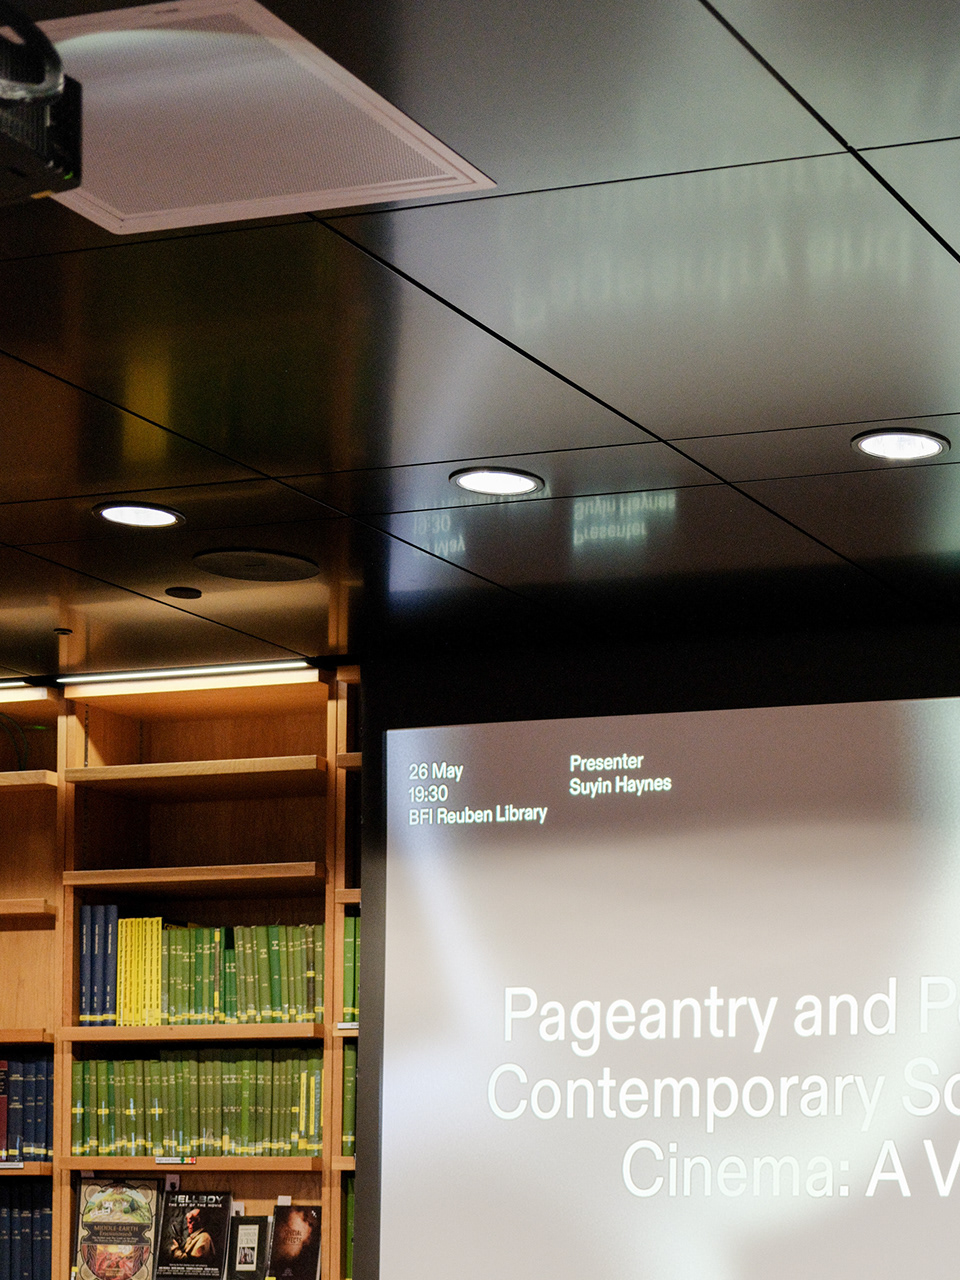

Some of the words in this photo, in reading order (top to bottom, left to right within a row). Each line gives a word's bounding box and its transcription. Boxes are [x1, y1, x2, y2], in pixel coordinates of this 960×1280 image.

[409, 763, 429, 780] 26
[432, 762, 464, 782] May
[569, 753, 645, 772] Presenter
[408, 785, 449, 802] 19:30
[569, 777, 612, 799] Suyin
[615, 775, 672, 796] Haynes
[409, 808, 433, 825] BFI
[437, 806, 493, 824] Reuben
[496, 804, 548, 824] Library
[502, 985, 779, 1058] Pageantry
[794, 977, 898, 1037] and
[487, 1062, 885, 1134] Contemporary
[622, 1138, 850, 1198] Cinema:
[865, 1139, 911, 1198] A
[169, 1194, 224, 1204] HELLBOY
